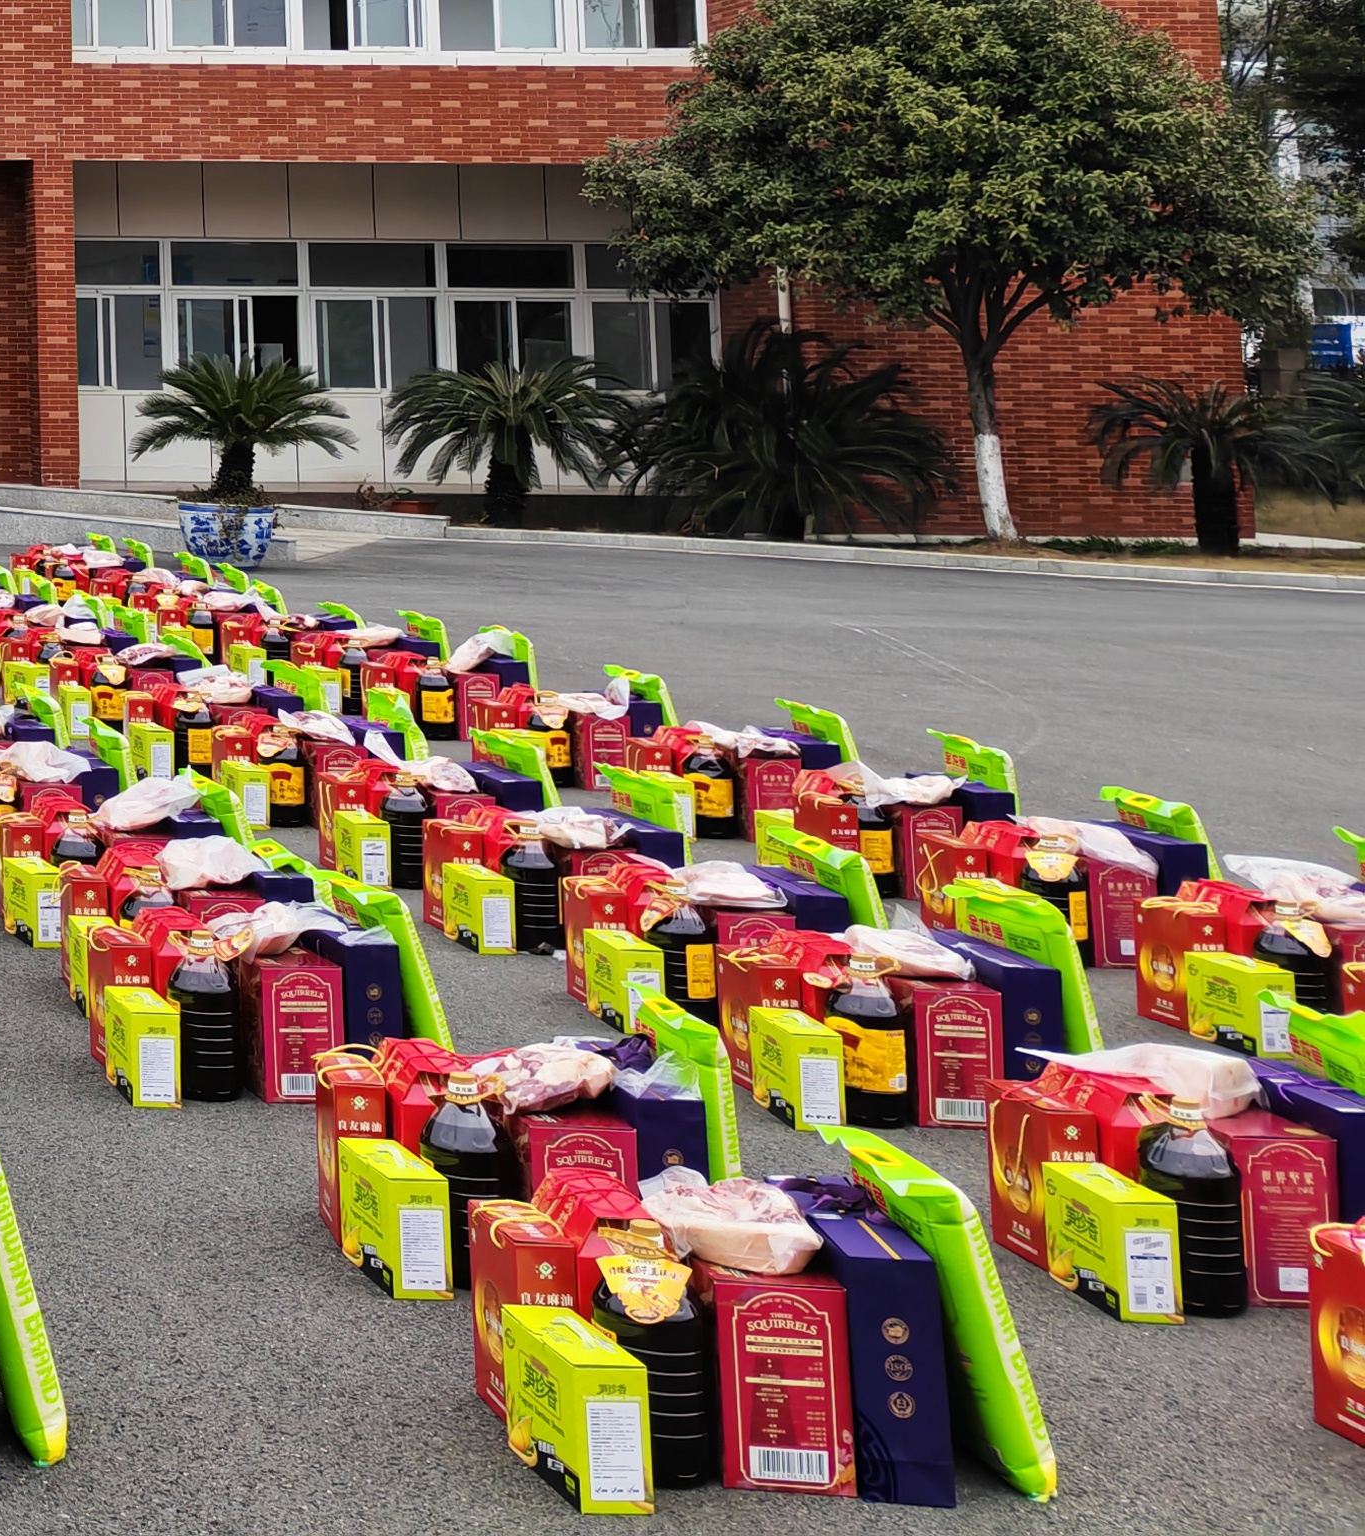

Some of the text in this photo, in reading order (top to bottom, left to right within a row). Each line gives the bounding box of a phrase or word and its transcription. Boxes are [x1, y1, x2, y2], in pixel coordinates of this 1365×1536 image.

[279, 988, 325, 999] SQUIRRELS
[337, 1119, 383, 1133] 良友麻油
[555, 1155, 614, 1168] SQUIRRELS
[520, 1292, 574, 1308] 良友麻油
[746, 1318, 819, 1336] SQUIRRELS
